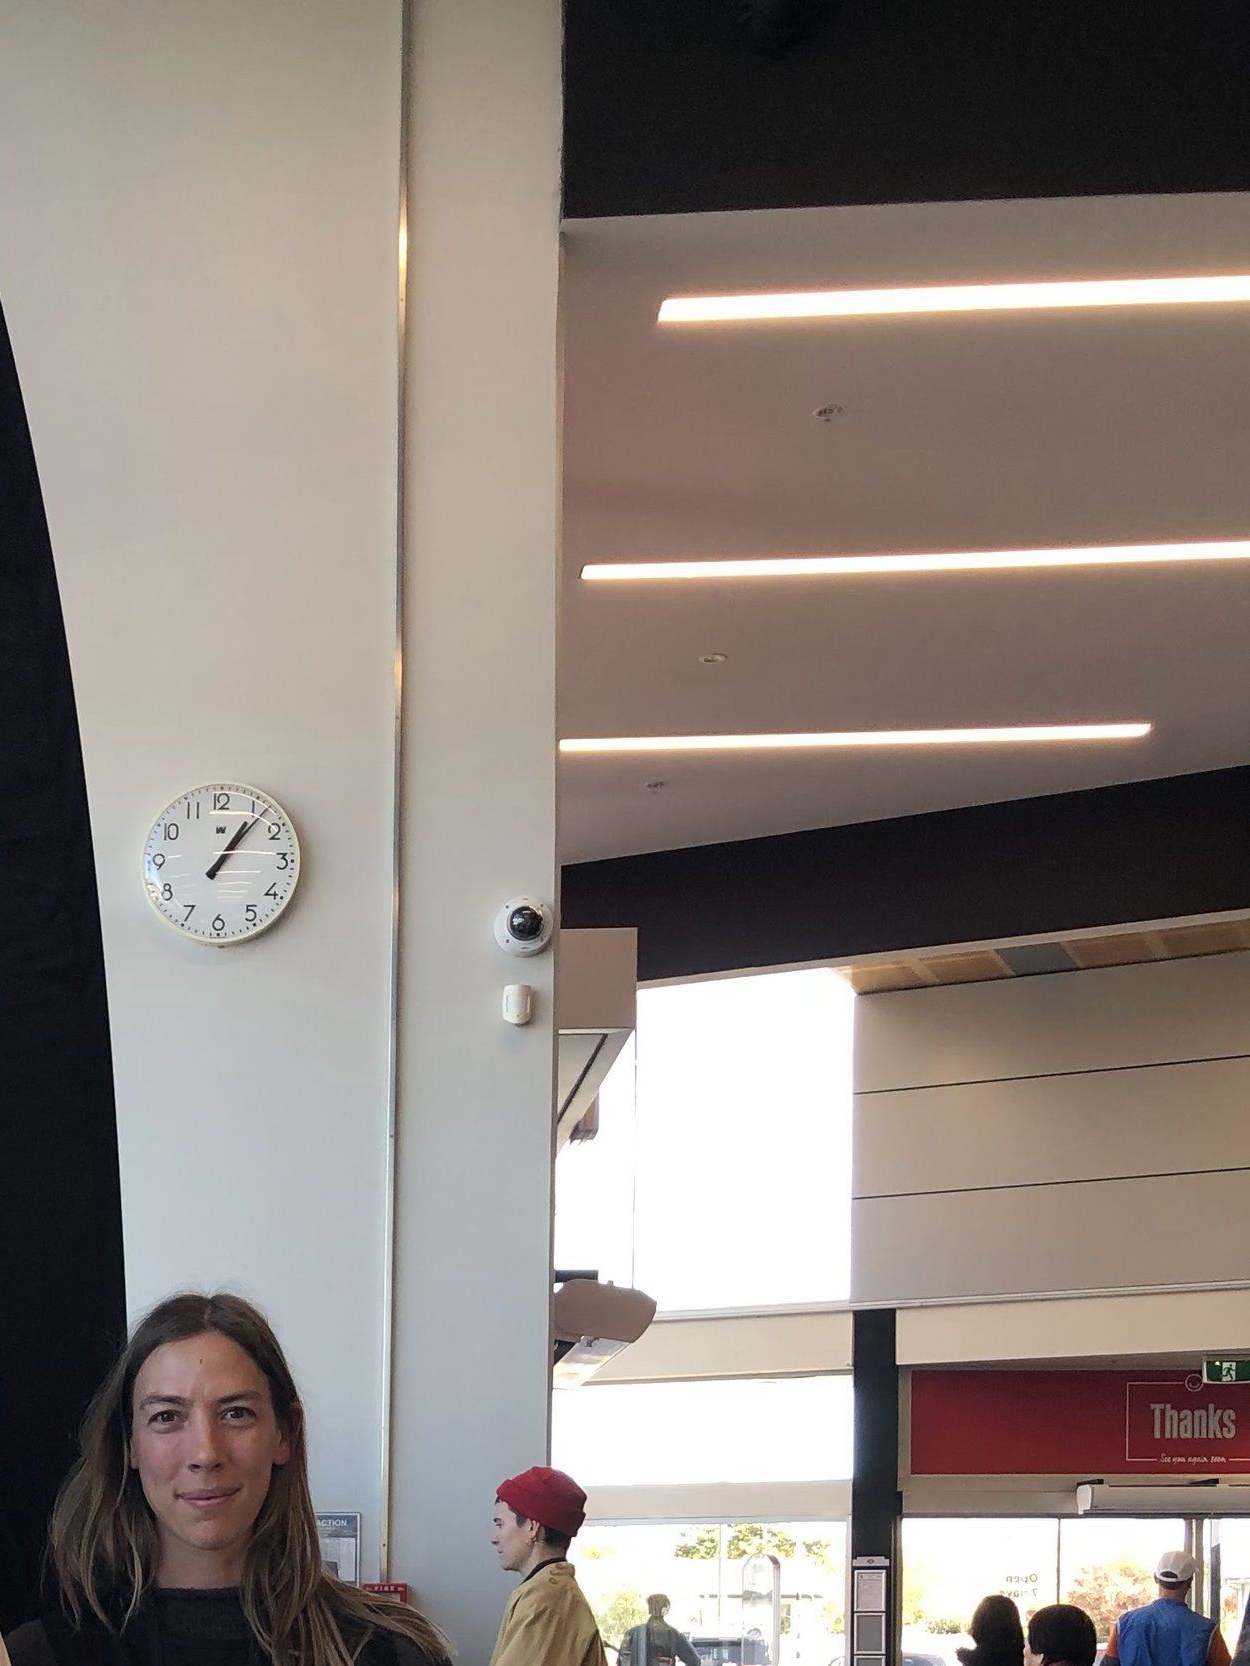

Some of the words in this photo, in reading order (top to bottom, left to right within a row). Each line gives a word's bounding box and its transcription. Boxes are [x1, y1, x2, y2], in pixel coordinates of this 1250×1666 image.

[213, 793, 230, 810] 12
[187, 802, 199, 819] 11
[164, 823, 179, 840] 10
[267, 823, 281, 840] 2
[152, 853, 166, 870] 9
[276, 852, 289, 870] 3
[161, 883, 173, 900] 8
[263, 883, 278, 900] 4
[182, 904, 196, 922] 7
[245, 904, 258, 922] 5
[212, 914, 225, 931] 6
[1150, 1403, 1237, 1439] Thanks
